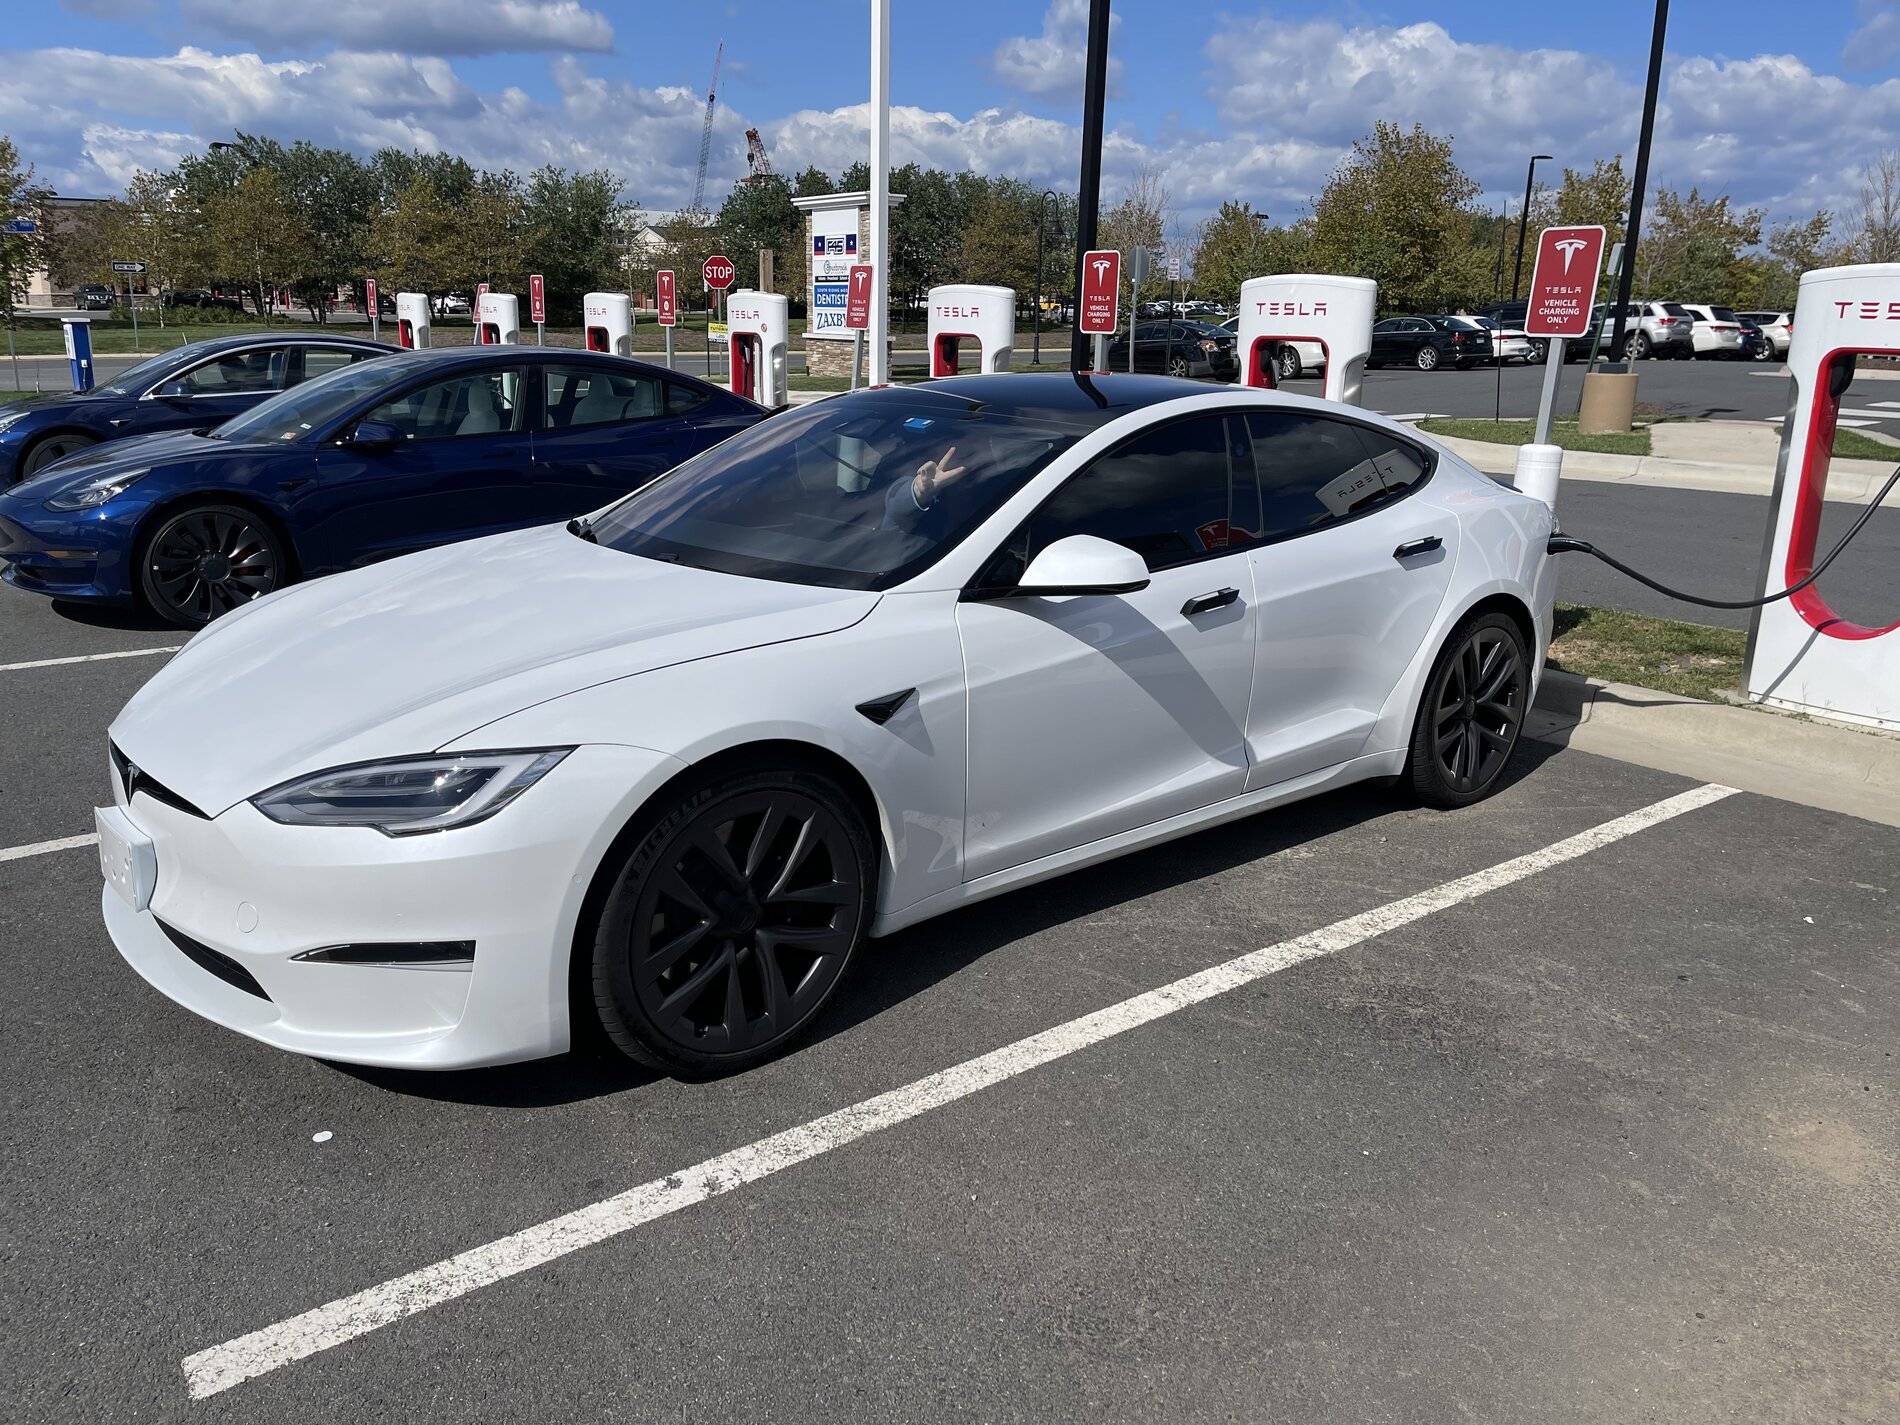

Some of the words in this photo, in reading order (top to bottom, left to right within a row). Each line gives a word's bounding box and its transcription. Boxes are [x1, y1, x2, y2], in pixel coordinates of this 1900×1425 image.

[705, 266, 732, 279] STOP
[1545, 286, 1582, 294] TESLA
[1544, 299, 1578, 307] VEHICLE
[586, 307, 607, 316] TESLA
[936, 306, 979, 318] TESLA
[1256, 302, 1327, 316] TESLA
[731, 310, 760, 319] TESLA
[1546, 316, 1569, 324] ONLY
